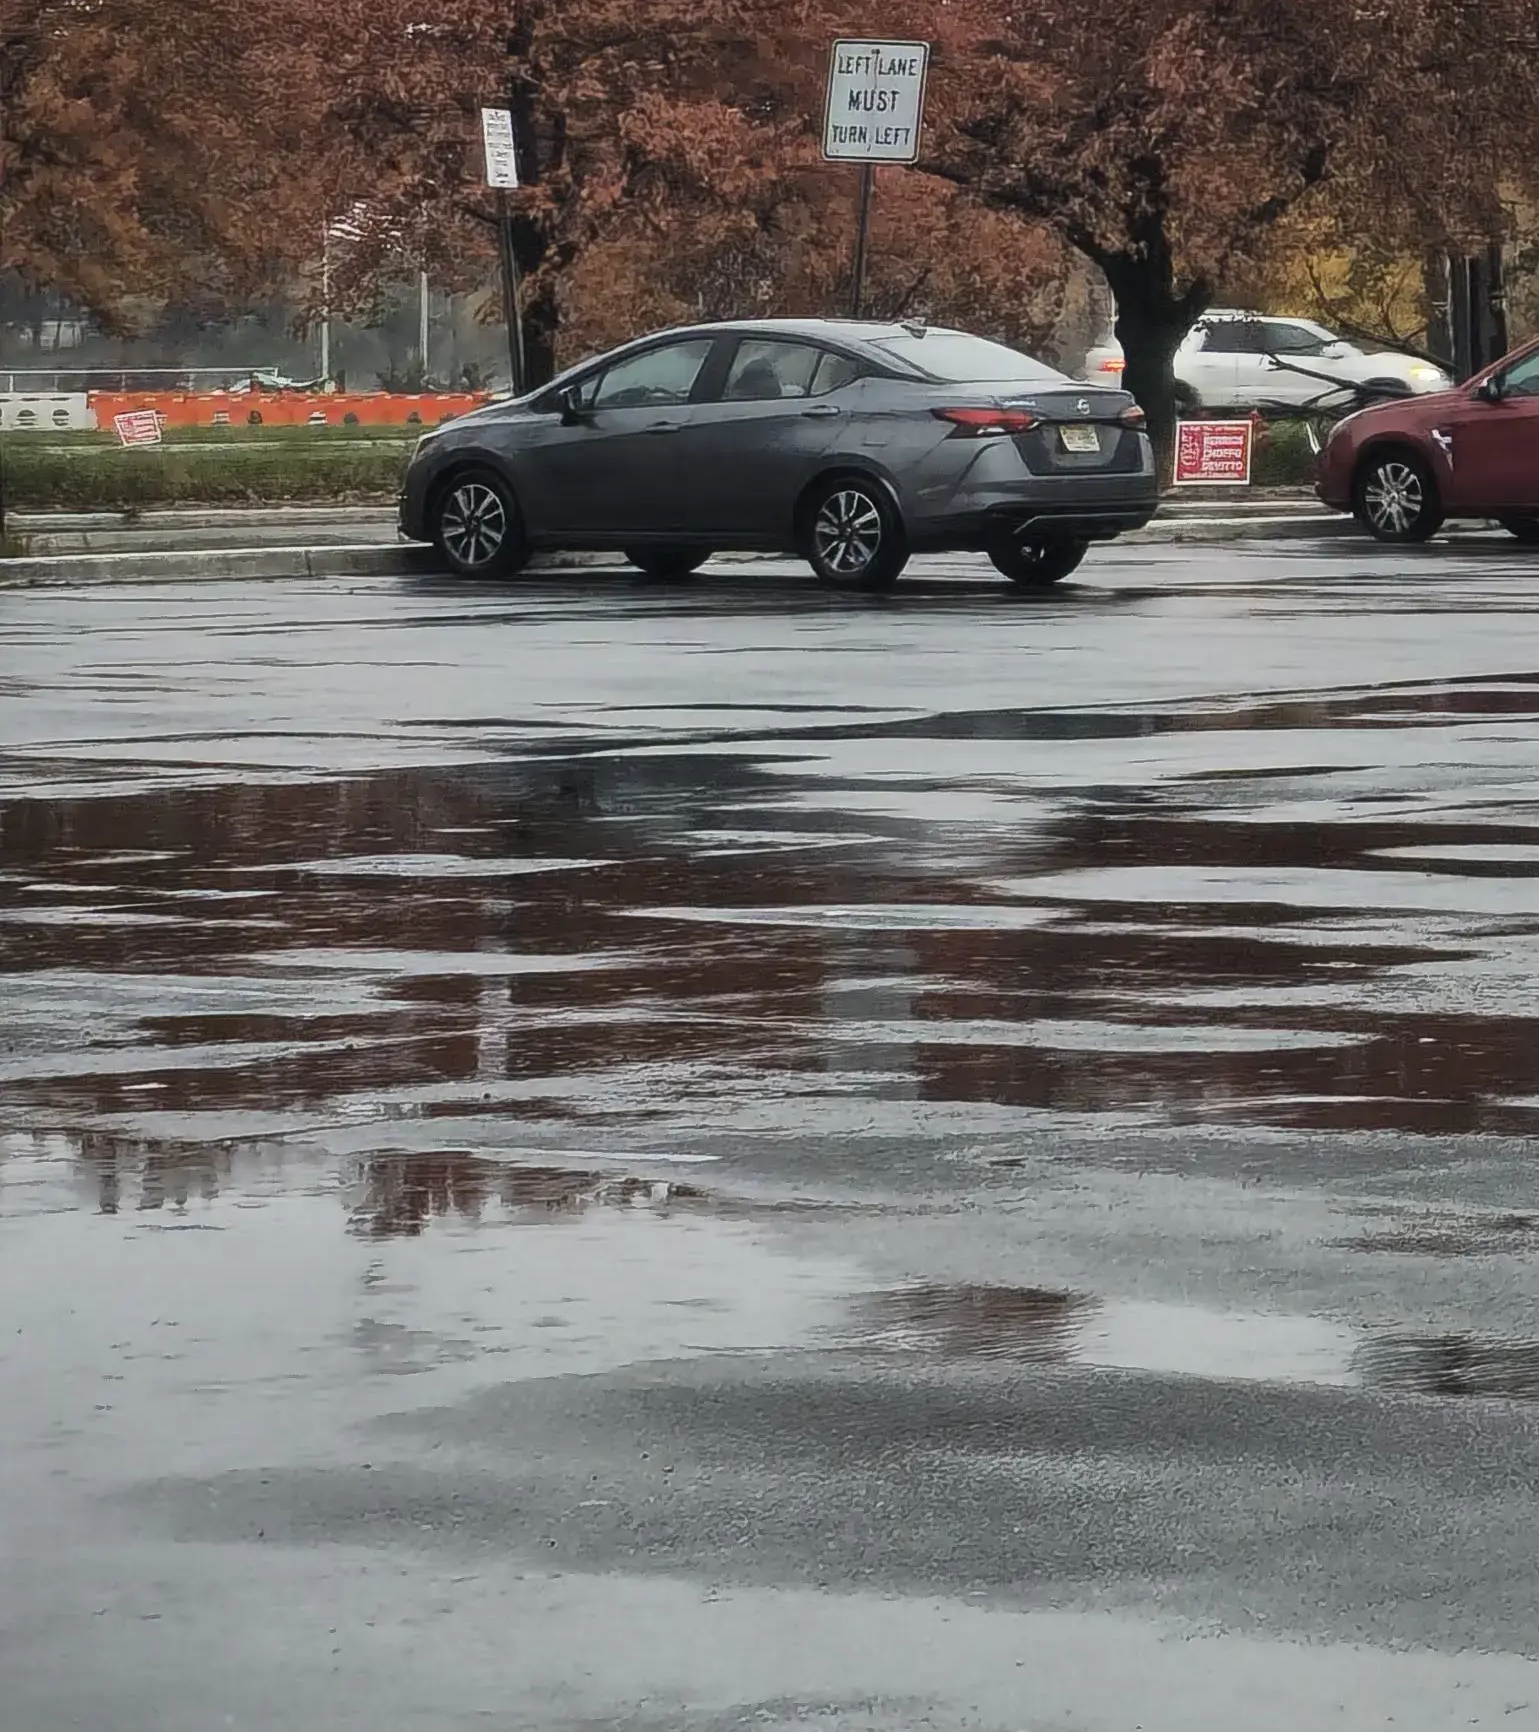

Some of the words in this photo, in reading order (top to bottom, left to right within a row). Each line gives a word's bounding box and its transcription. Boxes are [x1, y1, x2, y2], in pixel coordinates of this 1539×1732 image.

[837, 55, 872, 76] LEFT
[878, 57, 918, 77] LANE
[848, 89, 901, 112] MUST
[832, 124, 867, 144] TURN
[875, 126, 911, 145] LEFT
